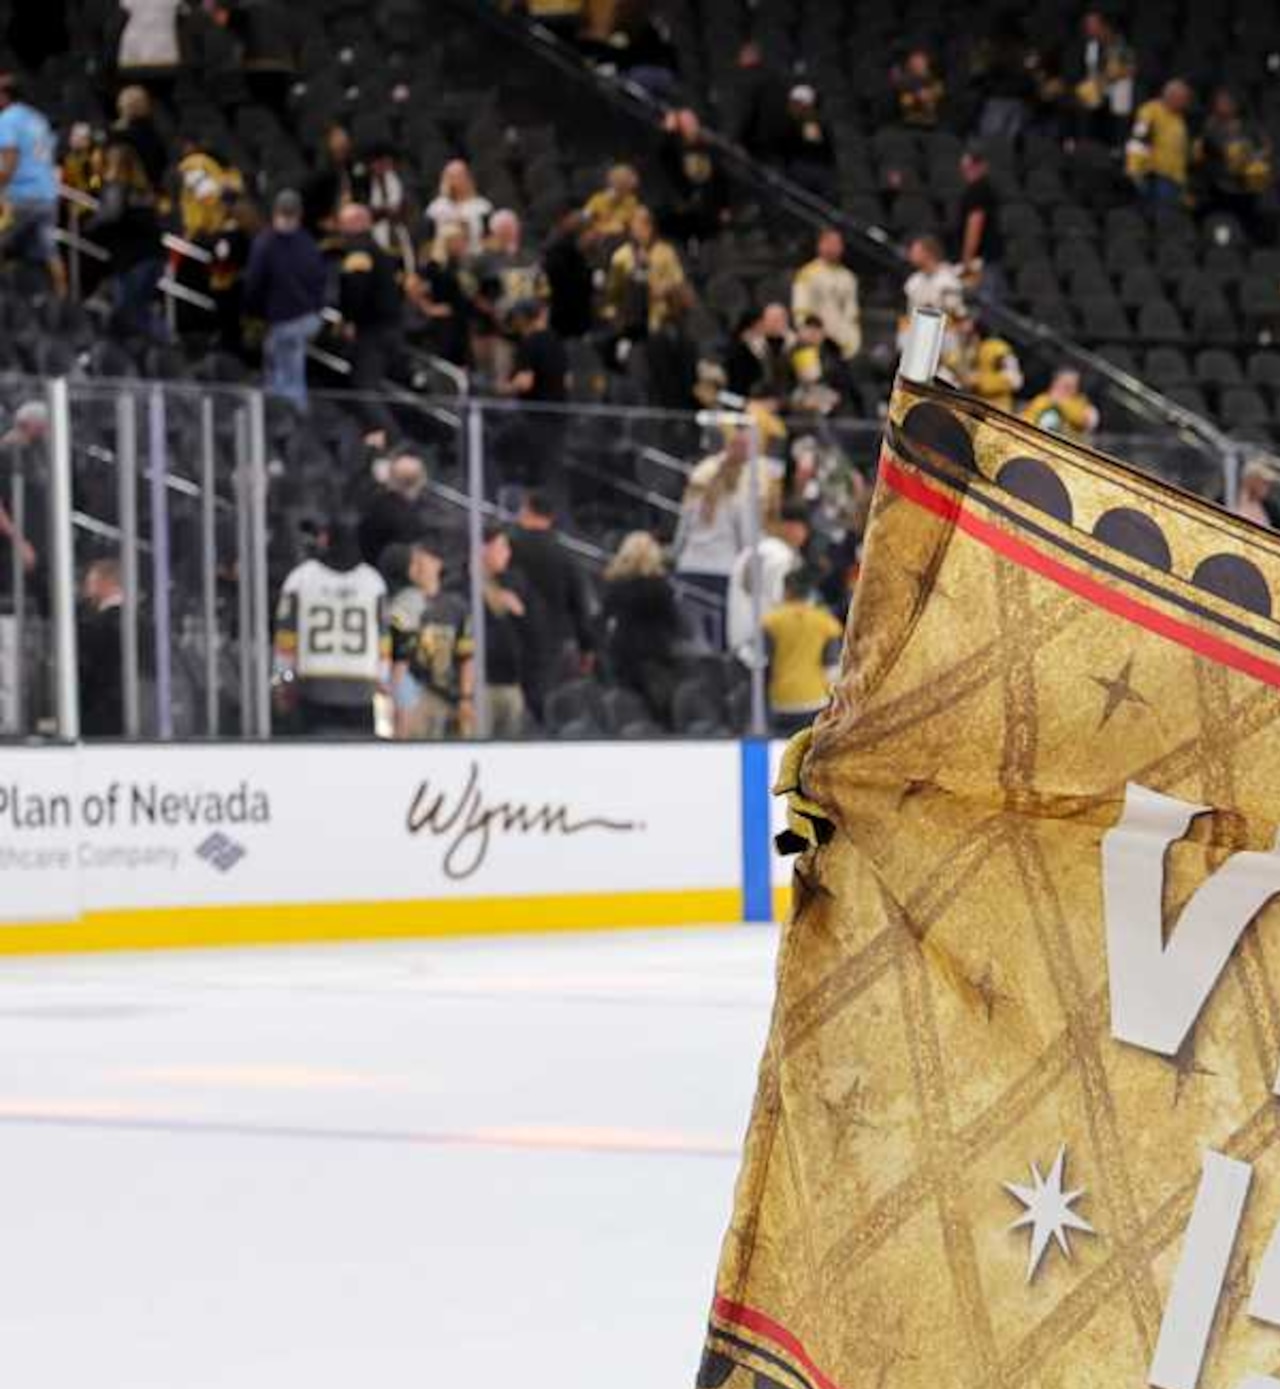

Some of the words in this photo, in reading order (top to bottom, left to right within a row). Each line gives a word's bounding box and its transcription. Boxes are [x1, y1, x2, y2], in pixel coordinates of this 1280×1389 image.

[308, 605, 368, 655] 29
[82, 782, 121, 826] of
[130, 780, 270, 825] Nevada
[406, 761, 634, 879] Wynn
